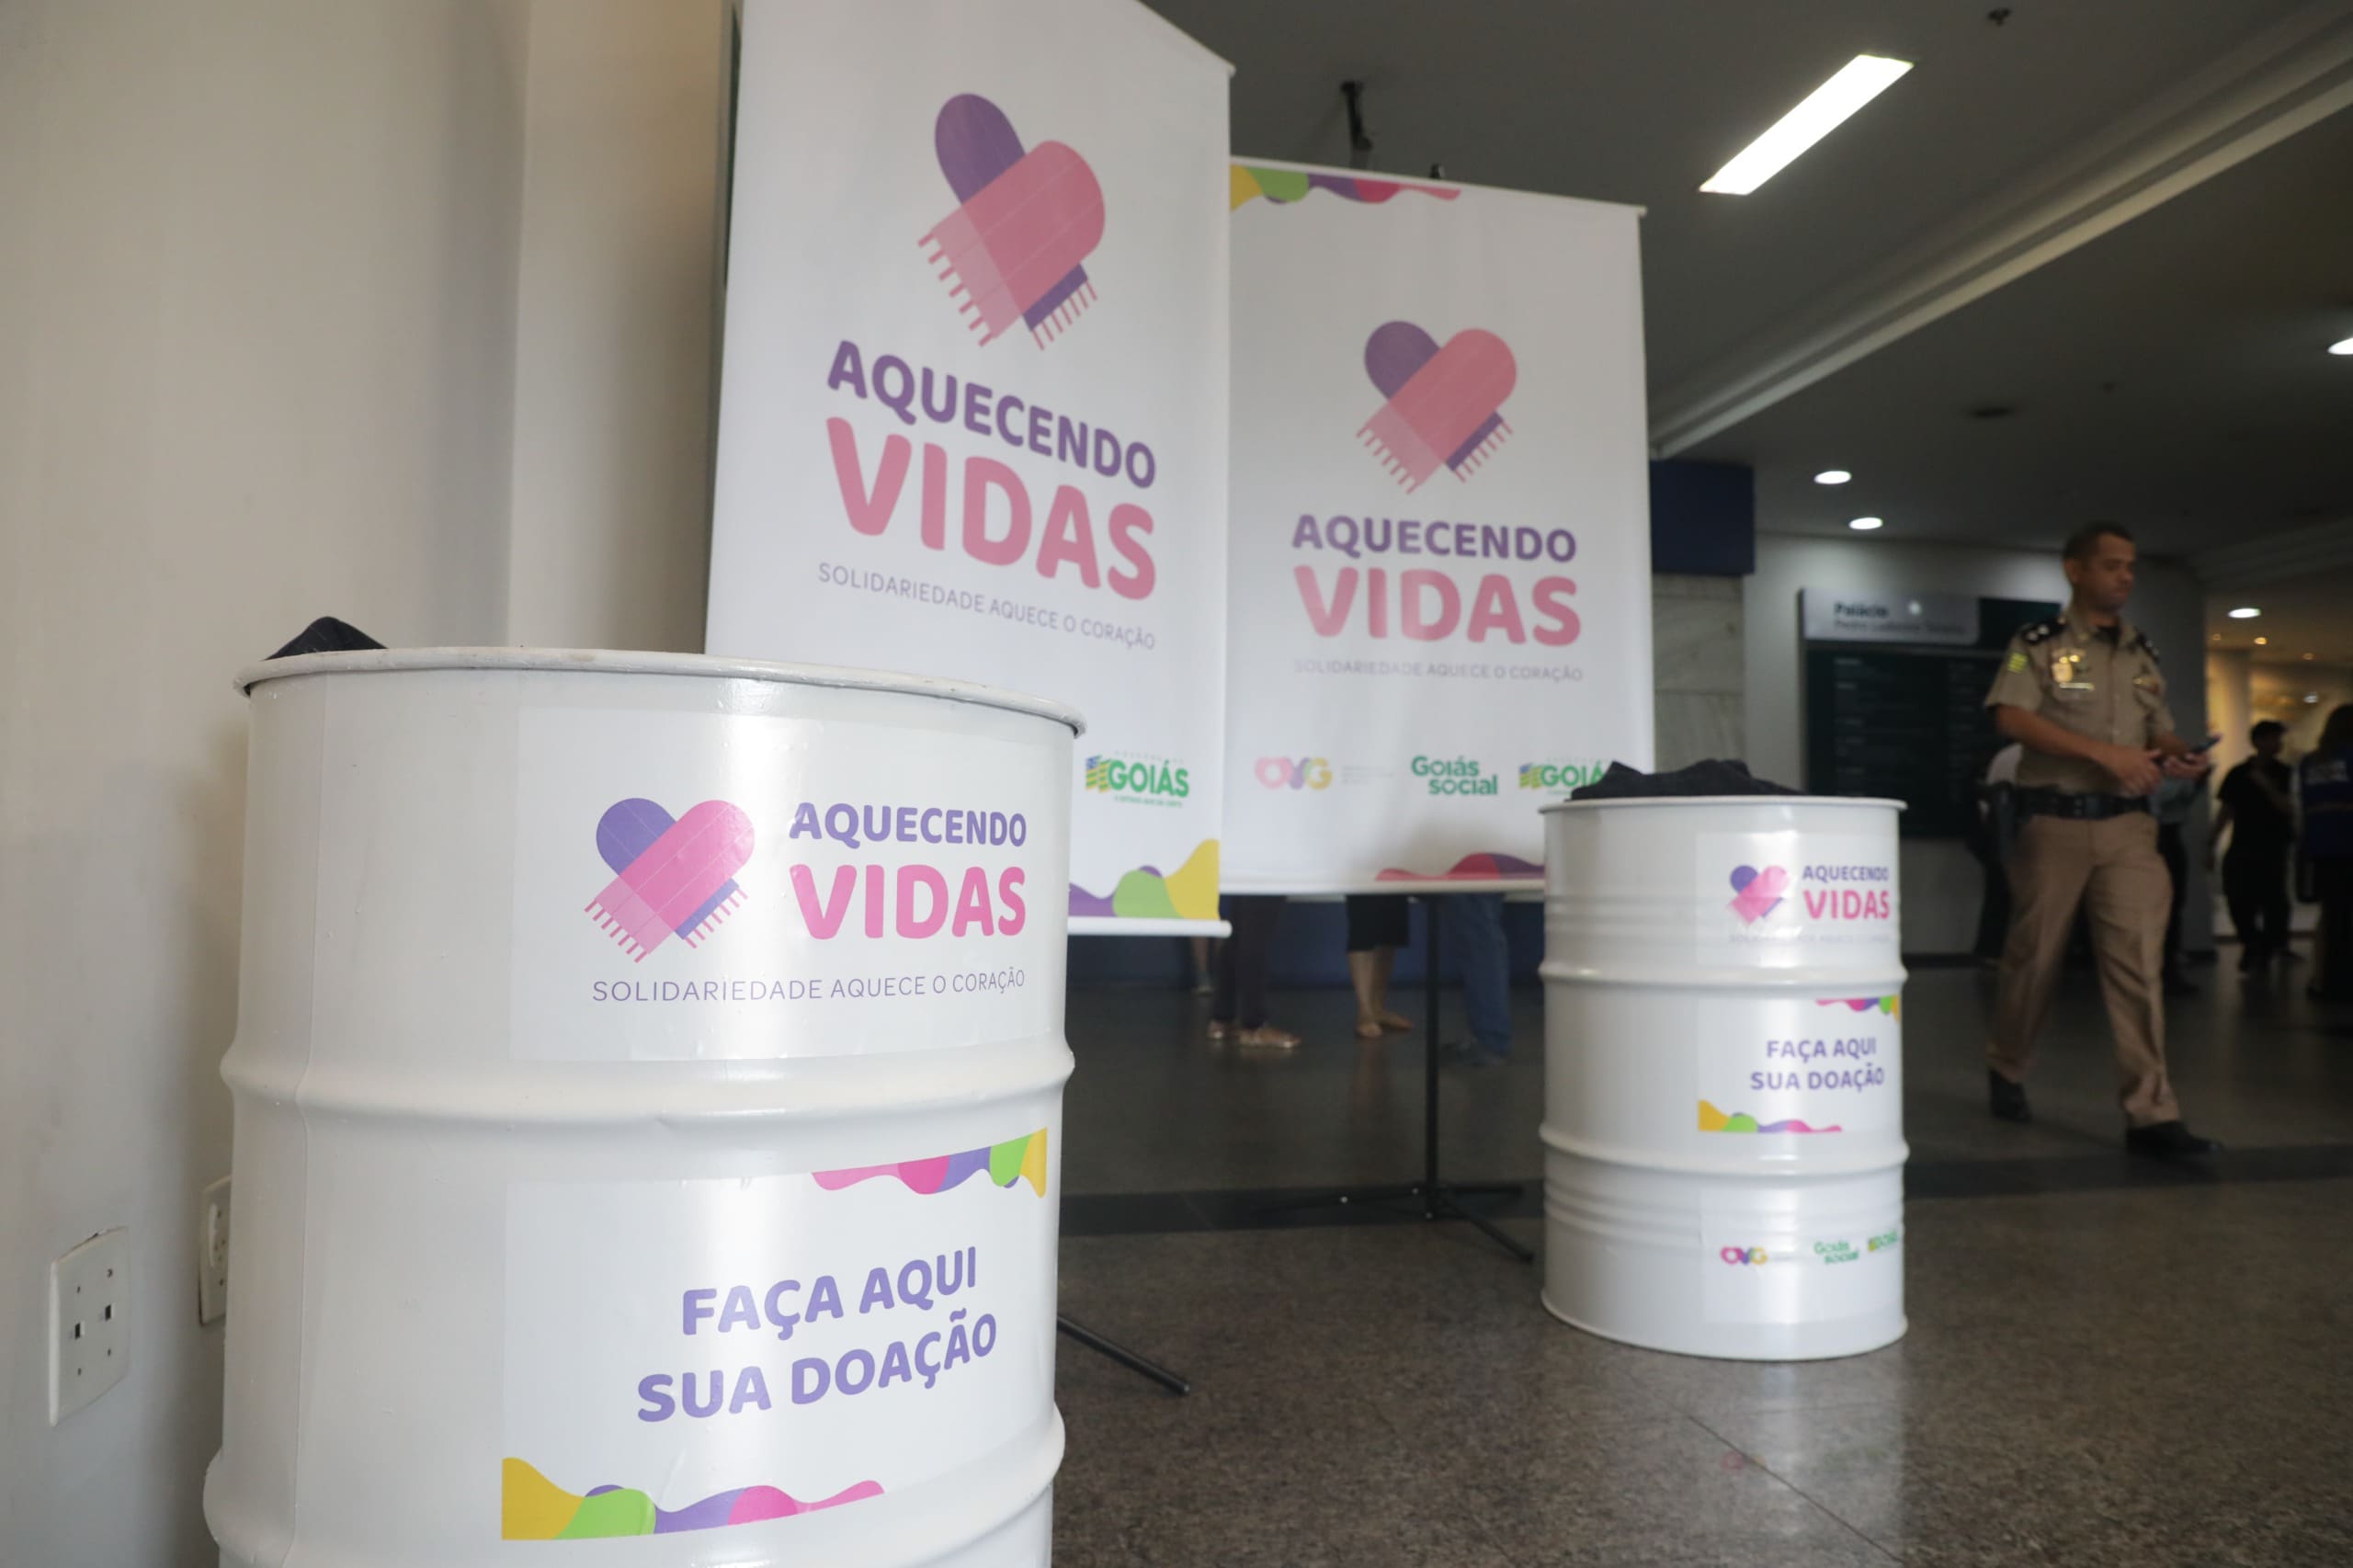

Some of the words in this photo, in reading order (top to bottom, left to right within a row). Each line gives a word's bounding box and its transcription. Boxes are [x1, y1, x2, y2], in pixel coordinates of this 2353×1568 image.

[827, 340, 1156, 489] AQUECENDO
[826, 416, 1156, 601] VIDAS
[1292, 514, 1577, 562] AQUECENDO
[818, 562, 985, 613] SOLIDARIEDADE
[990, 597, 1058, 630] AQUECE
[1063, 614, 1076, 634] O
[1081, 618, 1156, 651] CORAÇÃO
[1293, 564, 1581, 647] VIDAS
[1294, 658, 1423, 677] SOLIDARIEDADE
[1427, 663, 1490, 679] AQUECE
[1494, 665, 1507, 680] O
[1509, 664, 1585, 684] CORAÇÃO
[1108, 759, 1189, 798] GOIÁS
[1411, 755, 1481, 779] Goiás
[1428, 775, 1499, 797] social
[1540, 759, 1605, 788] GOIÁ
[789, 802, 1028, 849] AQUECENDO
[1802, 865, 1890, 883] AQUECENDO
[789, 863, 1027, 940] VIDAS
[1802, 889, 1891, 919] VIDAS
[592, 979, 824, 1003] SOLIDARIEDADE
[830, 975, 926, 999] AQUECE
[932, 974, 948, 995] O
[952, 967, 1026, 995] CORAÇÃO
[1767, 1040, 1827, 1062] FAÇA
[1833, 1038, 1877, 1059] AQUI
[1750, 1072, 1802, 1090] SUA
[1807, 1062, 1884, 1092] DOAÇÃO
[682, 1275, 845, 1341] FAÇA
[858, 1246, 977, 1314] AQUI
[638, 1366, 772, 1423] SUA
[791, 1308, 997, 1405] DOAÇÃO
